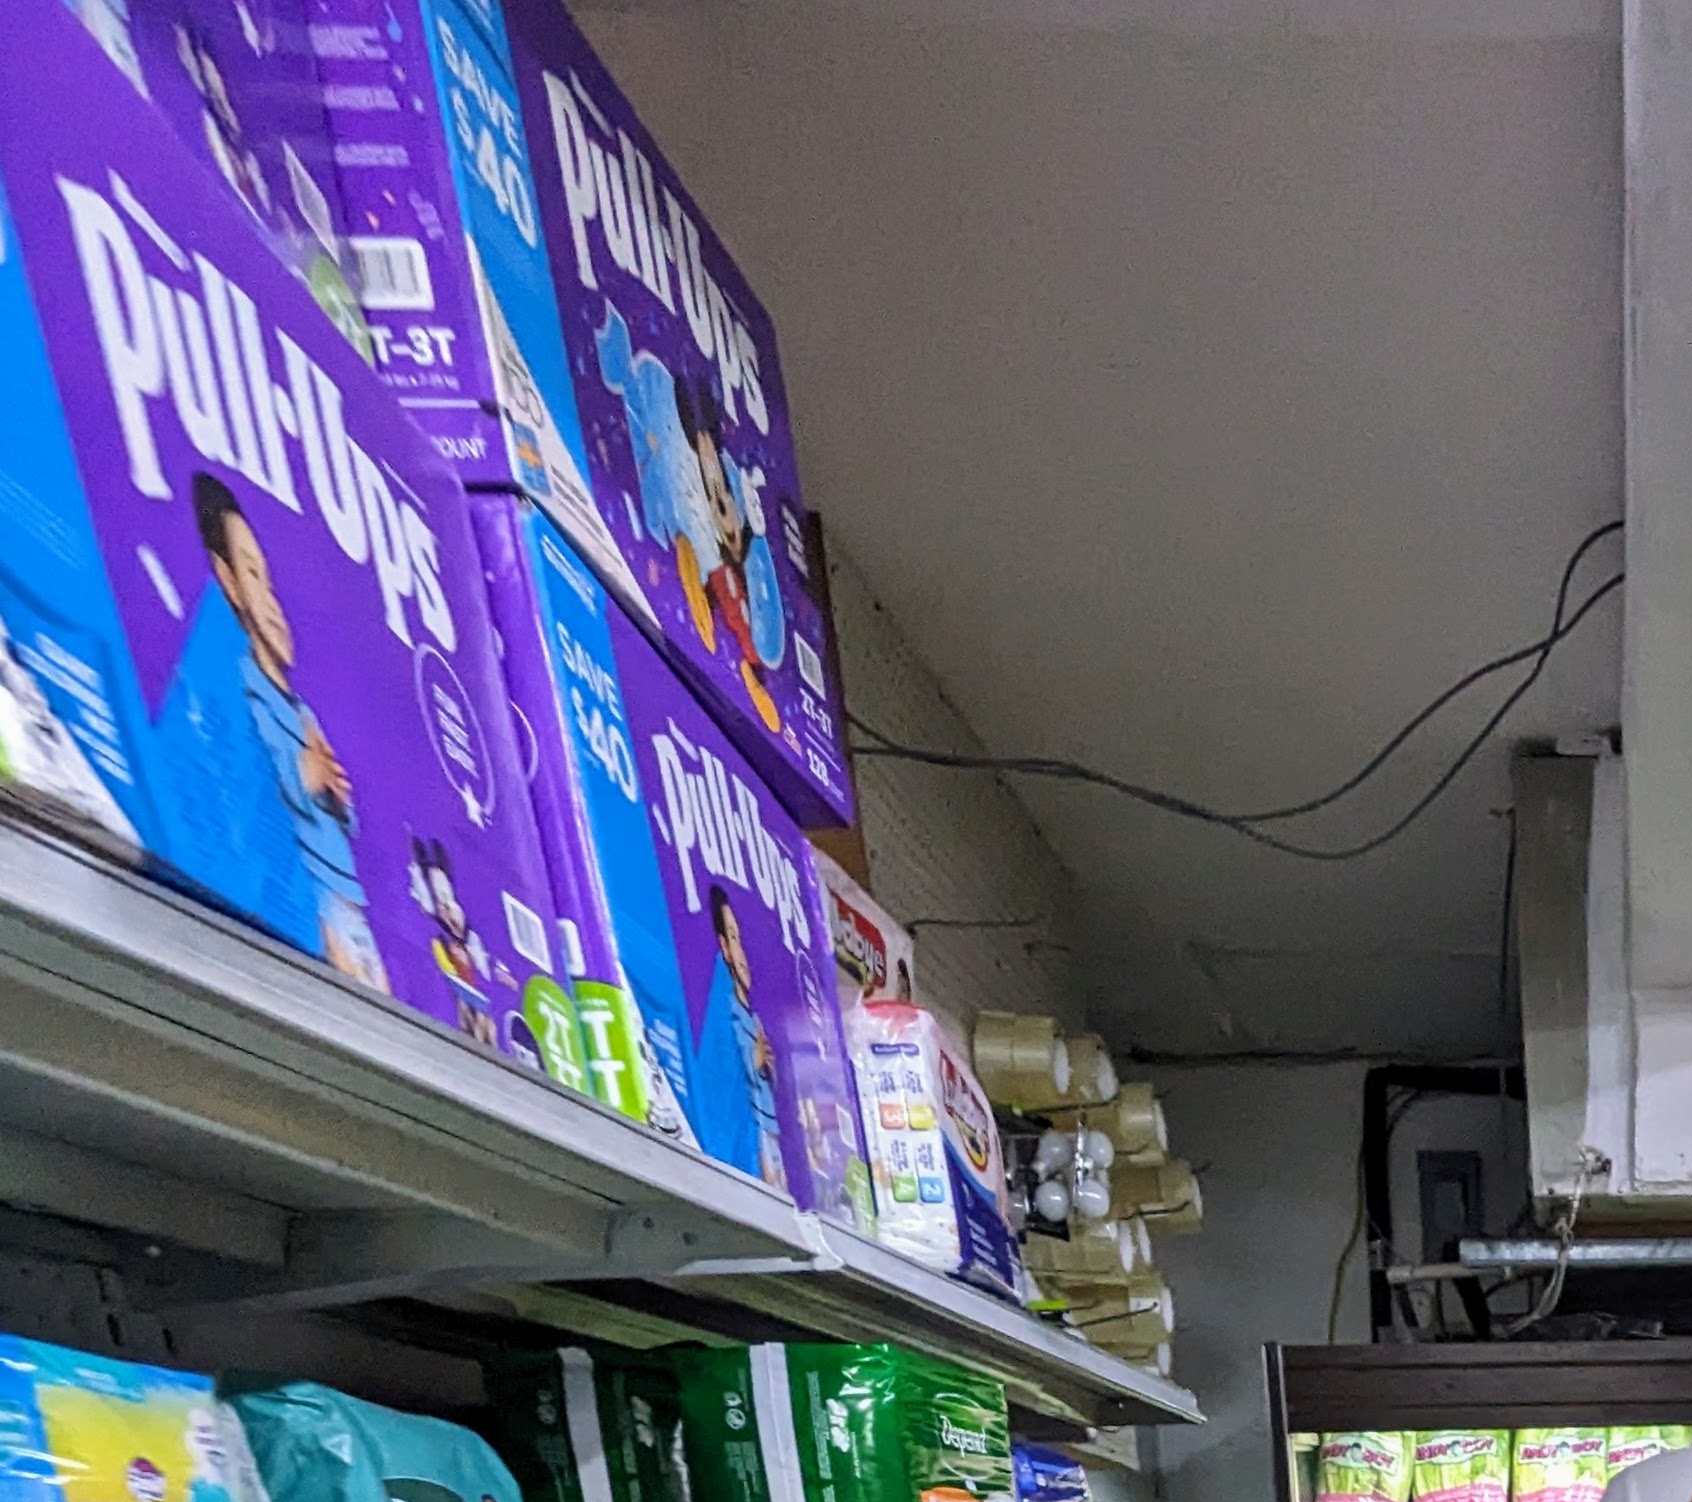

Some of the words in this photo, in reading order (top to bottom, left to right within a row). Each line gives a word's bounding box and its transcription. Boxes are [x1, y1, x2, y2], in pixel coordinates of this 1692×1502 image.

[437, 14, 523, 160] SAVE
[450, 86, 538, 249] $40
[372, 325, 456, 368] T-3T
[557, 620, 623, 721] SAVE
[570, 686, 638, 804] $40
[578, 1010, 616, 1058] T
[591, 1060, 627, 1107] T
